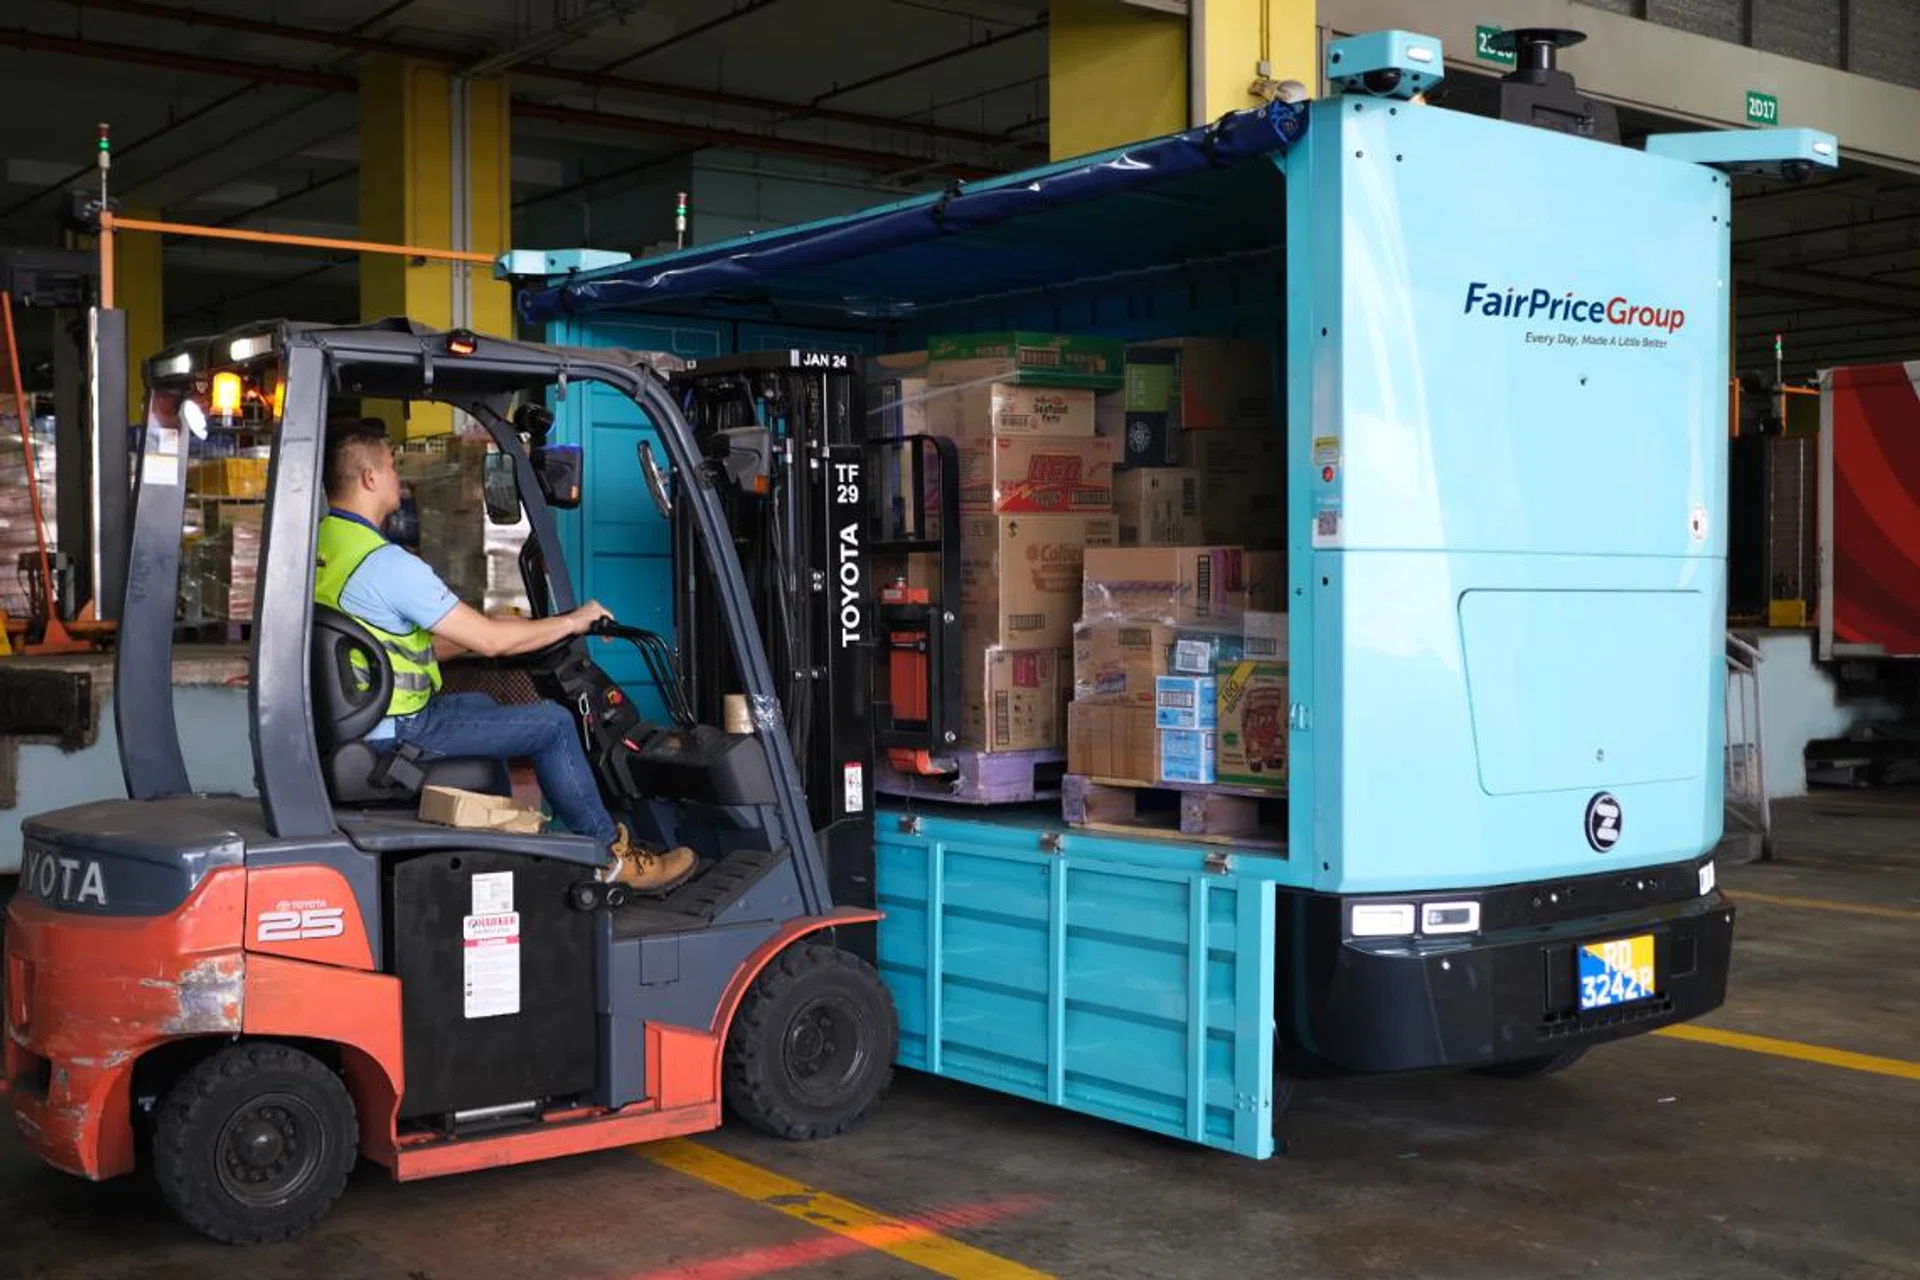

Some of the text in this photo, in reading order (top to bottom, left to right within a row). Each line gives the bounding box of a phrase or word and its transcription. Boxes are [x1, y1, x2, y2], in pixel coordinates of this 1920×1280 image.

[1748, 97, 1775, 120] 2017
[1525, 332, 1667, 348] Every Day, Made A Little Better
[803, 353, 847, 368] JAN 24
[835, 464, 859, 483] TF
[837, 484, 859, 503] 29
[840, 523, 860, 648] TOYOTA
[21, 849, 107, 906] YOTA
[258, 908, 344, 942] 25
